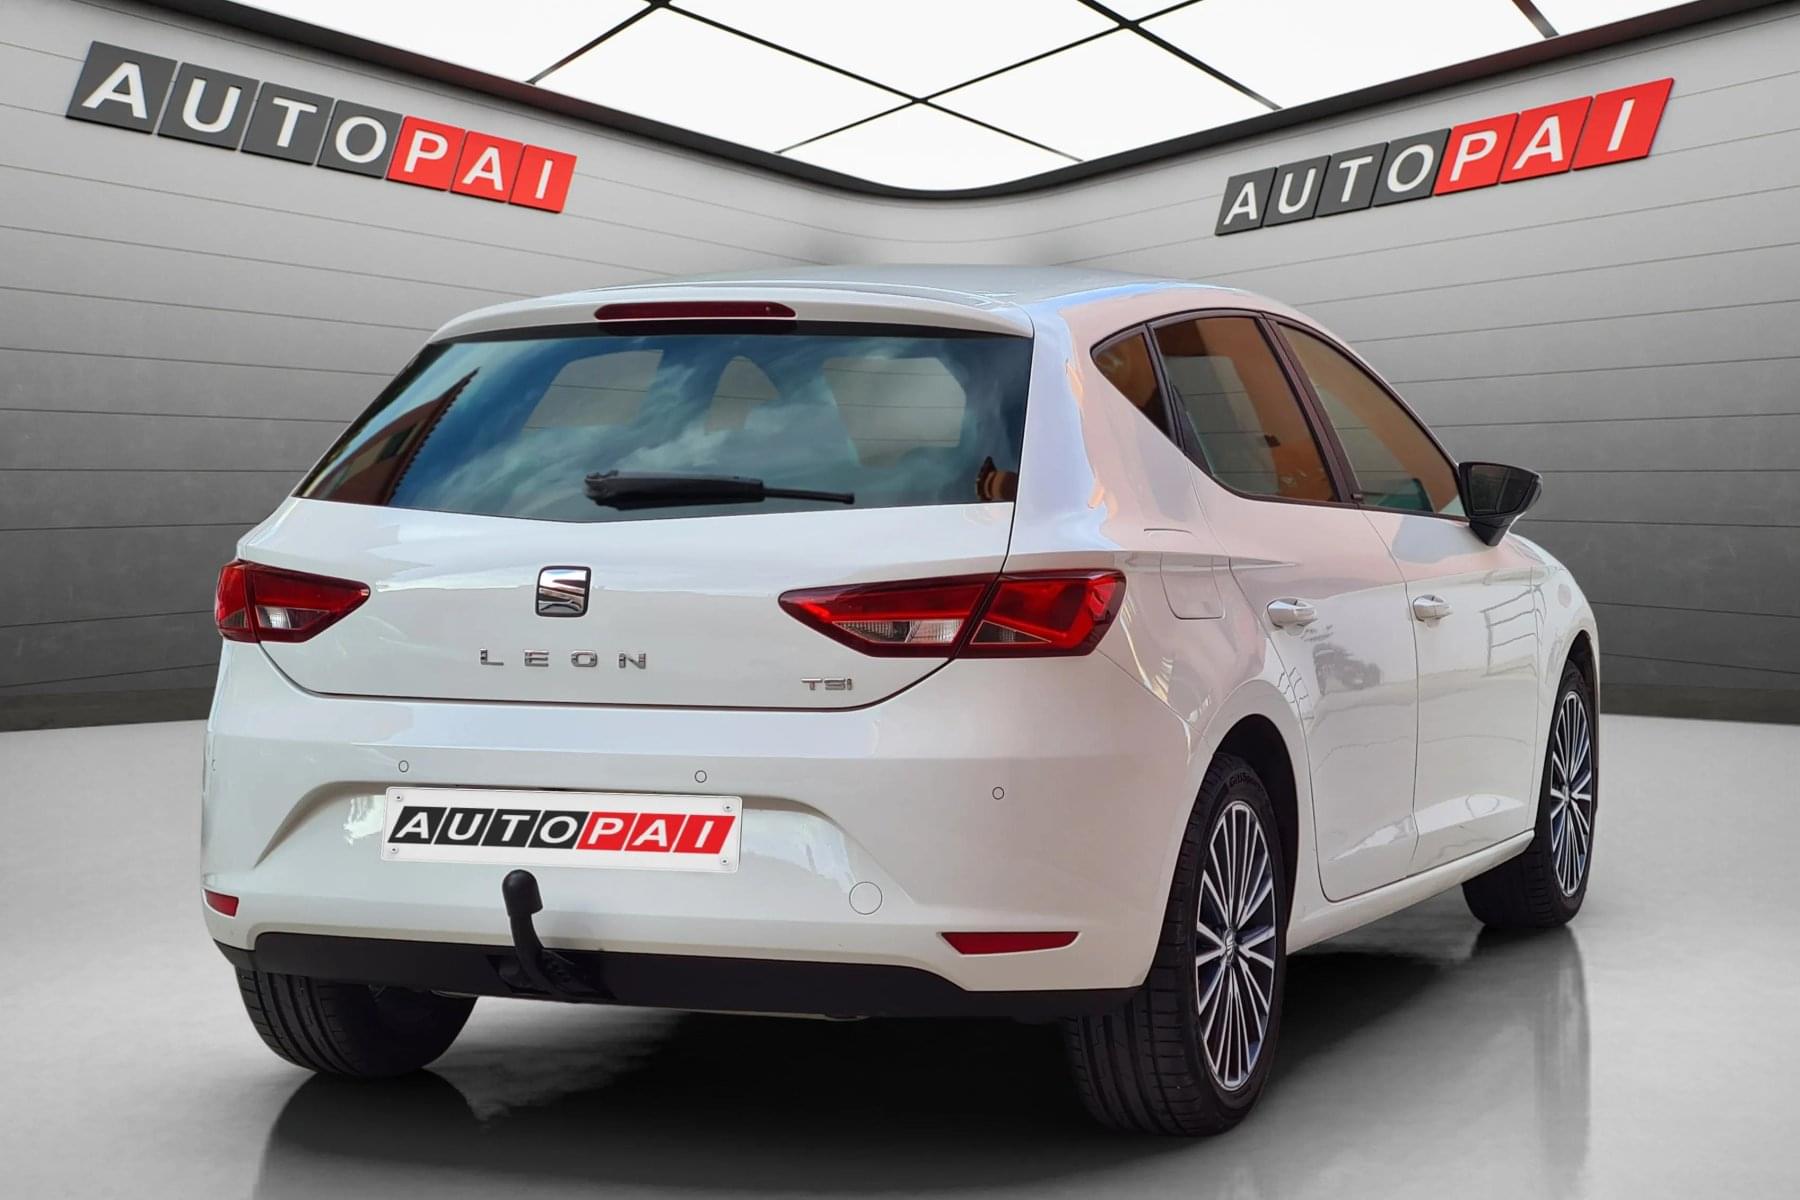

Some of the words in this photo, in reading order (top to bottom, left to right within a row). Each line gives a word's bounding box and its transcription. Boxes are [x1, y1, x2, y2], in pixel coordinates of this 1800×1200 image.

[82, 62, 556, 200] AUTOPAI
[1223, 99, 1635, 226] AUTOPAI
[480, 648, 647, 669] LEON
[396, 811, 711, 848] AUTOPAI
